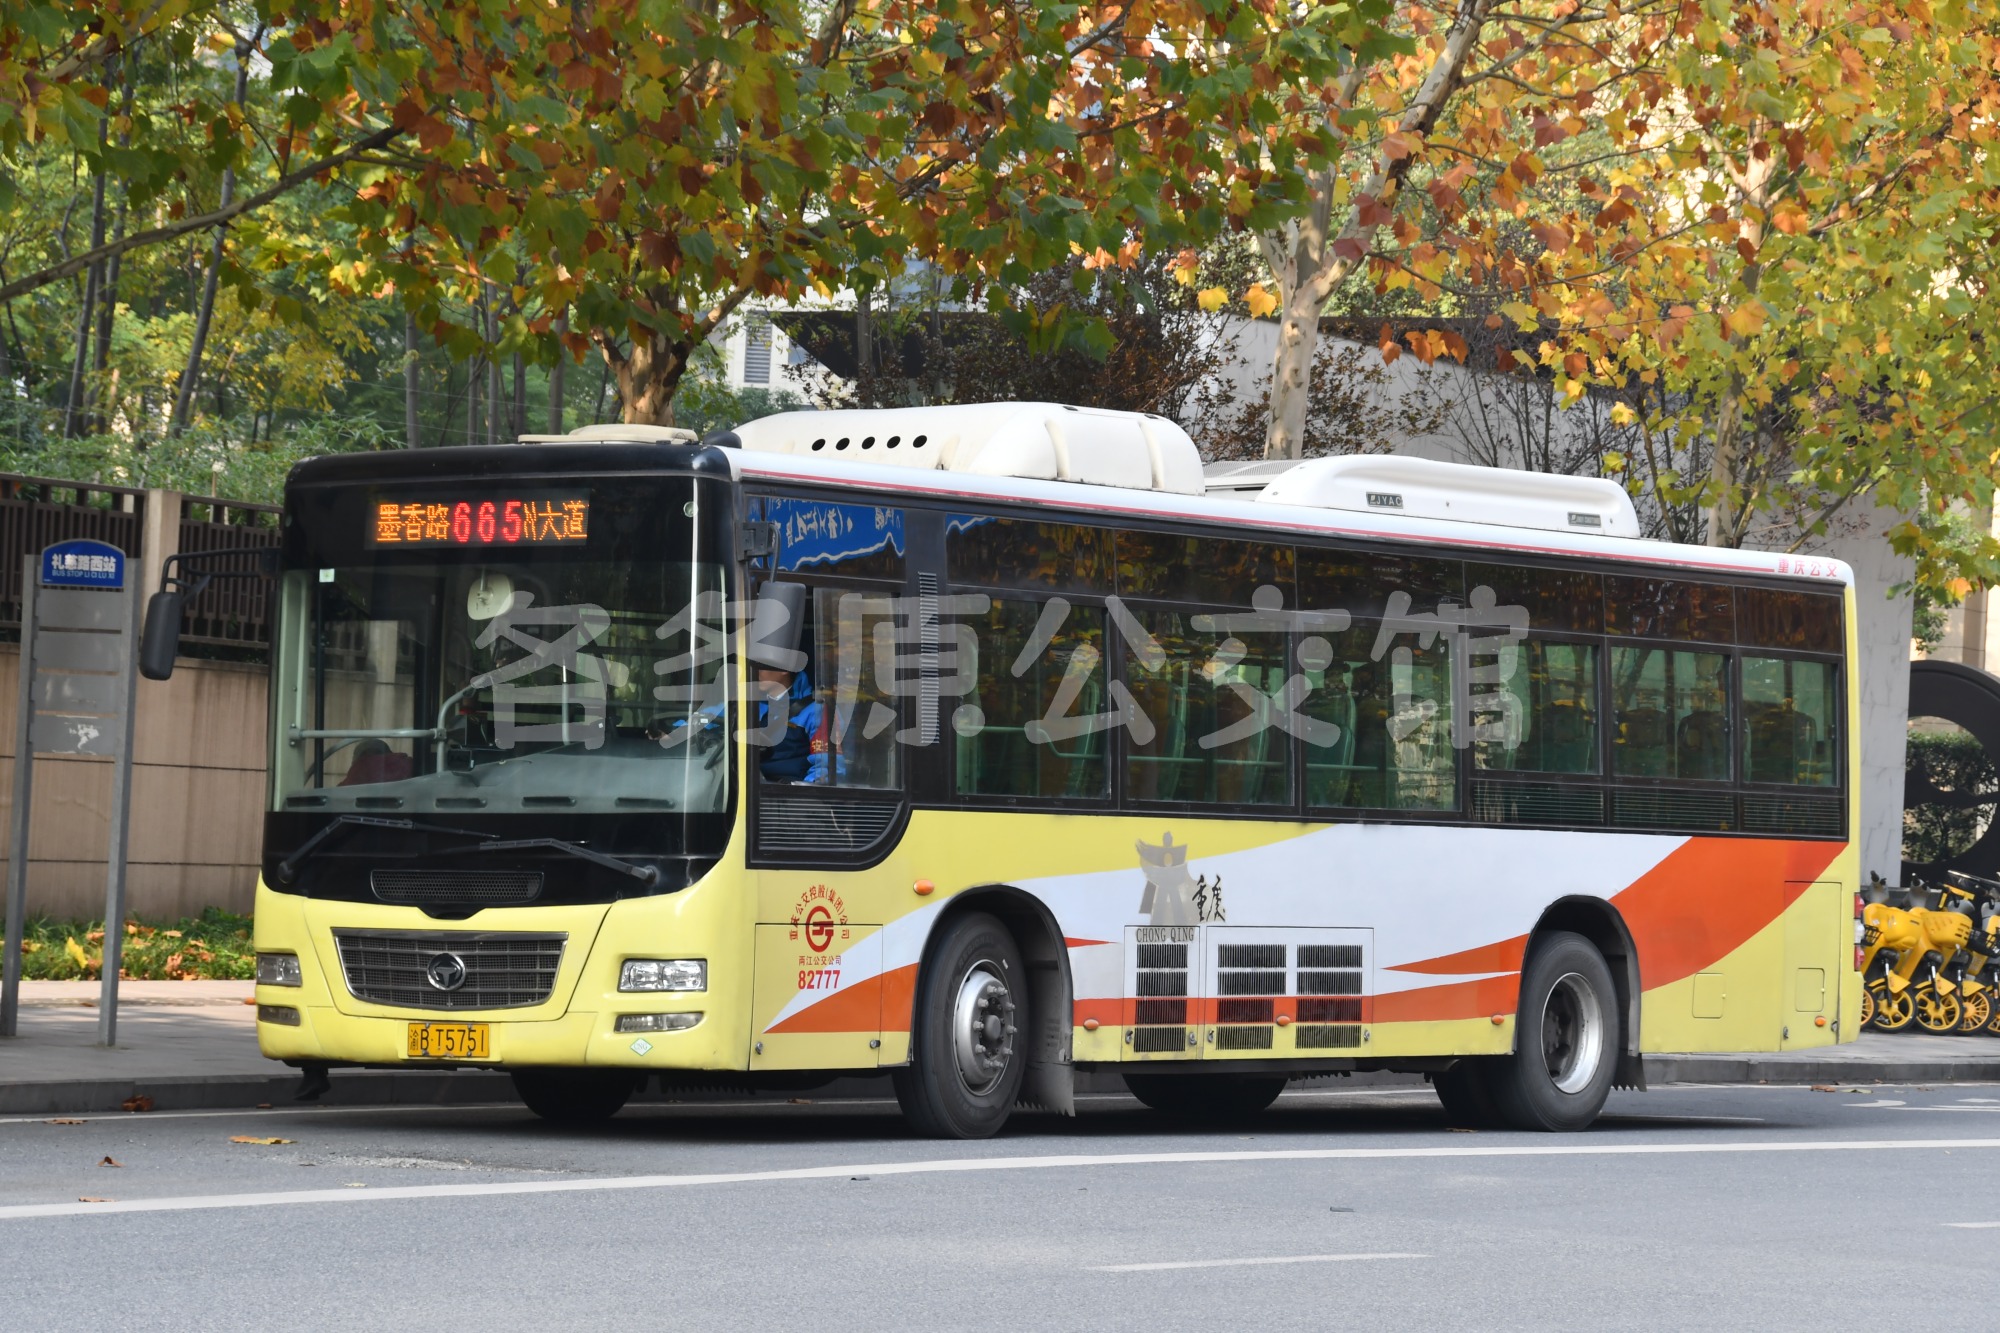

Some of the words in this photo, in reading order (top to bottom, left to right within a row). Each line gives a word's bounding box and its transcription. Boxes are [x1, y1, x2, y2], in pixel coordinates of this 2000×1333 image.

[376, 503, 450, 541] 墨香路
[453, 501, 522, 542] 665
[1778, 559, 1837, 577] 重庆公交
[1136, 927, 1166, 943] CHONG
[1170, 927, 1194, 943] QING
[798, 955, 842, 966] 两江公交公司
[798, 970, 841, 989] 82777
